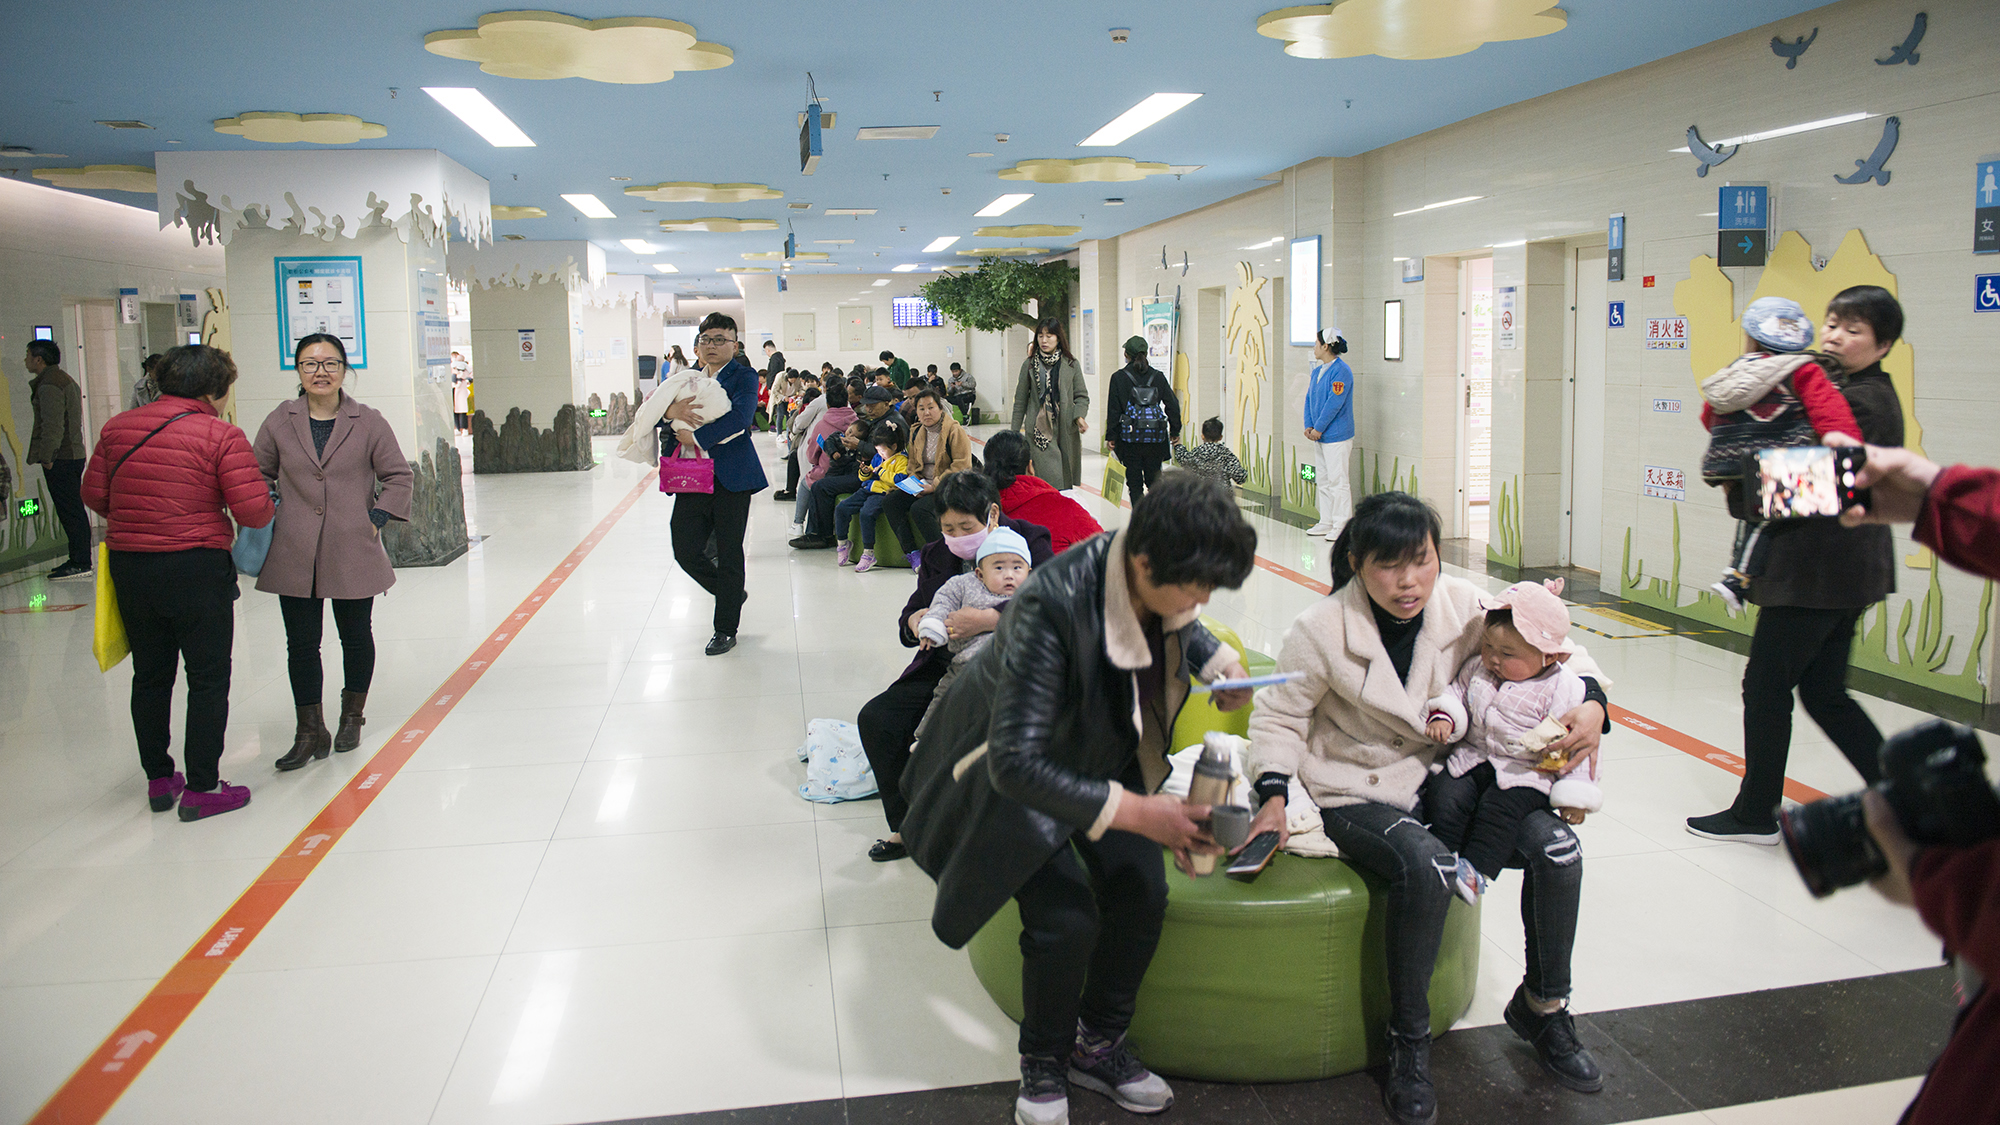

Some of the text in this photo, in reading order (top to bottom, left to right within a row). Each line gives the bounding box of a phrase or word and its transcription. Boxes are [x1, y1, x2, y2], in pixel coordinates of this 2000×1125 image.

[1735, 217, 1756, 226] 洗手间
[1981, 218, 1994, 233] 女
[1611, 256, 1618, 267] 男
[1649, 319, 1685, 338] 消火栓
[1654, 400, 1680, 412] 火警119
[1646, 469, 1684, 490] 灭火器箱
